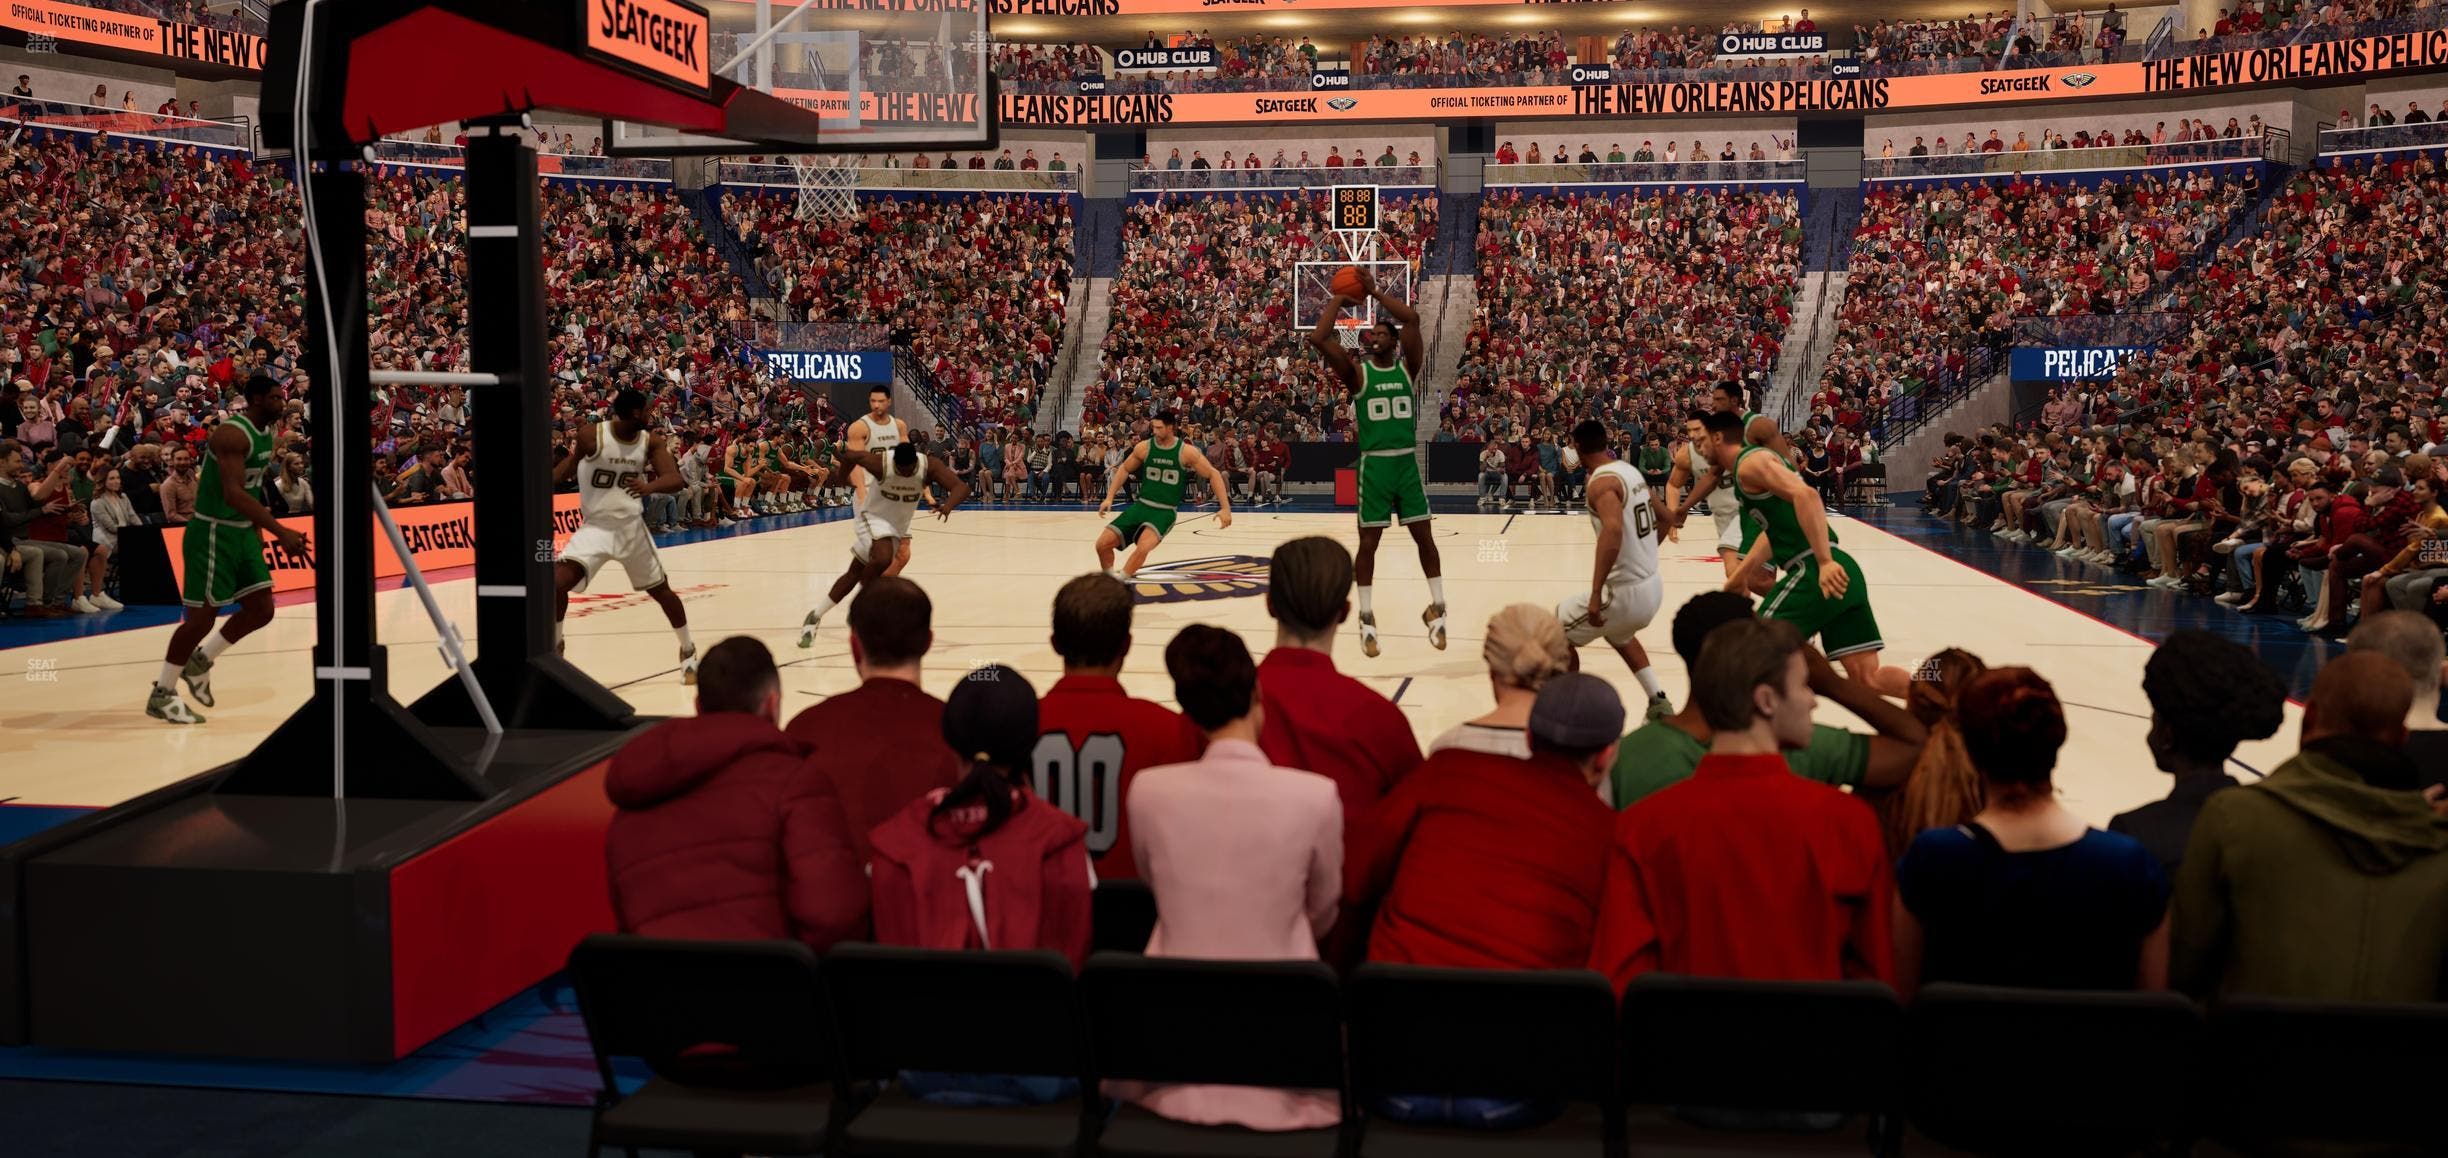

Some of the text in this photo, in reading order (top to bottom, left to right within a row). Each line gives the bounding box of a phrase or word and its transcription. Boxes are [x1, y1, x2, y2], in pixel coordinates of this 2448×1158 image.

[11, 4, 45, 23] OFFICIAL
[48, 12, 97, 32] TICKETING
[100, 22, 141, 39] PARTNER
[143, 29, 154, 41] OF
[158, 20, 199, 58] THE
[203, 28, 250, 68] NEW
[601, 0, 698, 72] SEATGEEK
[1743, 36, 1822, 50] HUB CLUB
[1137, 51, 1210, 64] HUB CLUB
[2142, 30, 2448, 92] THE NEW ORLEANS PELIC
[1089, 82, 1104, 90] HUB
[1326, 77, 1348, 86] HUB
[1587, 72, 1609, 80] HUB
[1980, 74, 2051, 95] SEATGEEK
[1255, 98, 1317, 114] SEATGEEK
[1431, 78, 1889, 115] OFFICIAL TICKETING PARTNER OF THE NEW ORLEANS PELICANS
[874, 92, 915, 121] THE
[918, 93, 967, 121] NEW
[1073, 94, 1173, 123] PELICANS
[1340, 190, 1370, 202] 88 88
[1343, 205, 1367, 226] 88
[768, 353, 862, 380] PELICANS
[1367, 397, 1413, 421] 00
[608, 458, 637, 466] TEAM
[1146, 467, 1180, 485] 00
[403, 515, 475, 554] EATGEEK
[1031, 732, 1125, 855] 00
